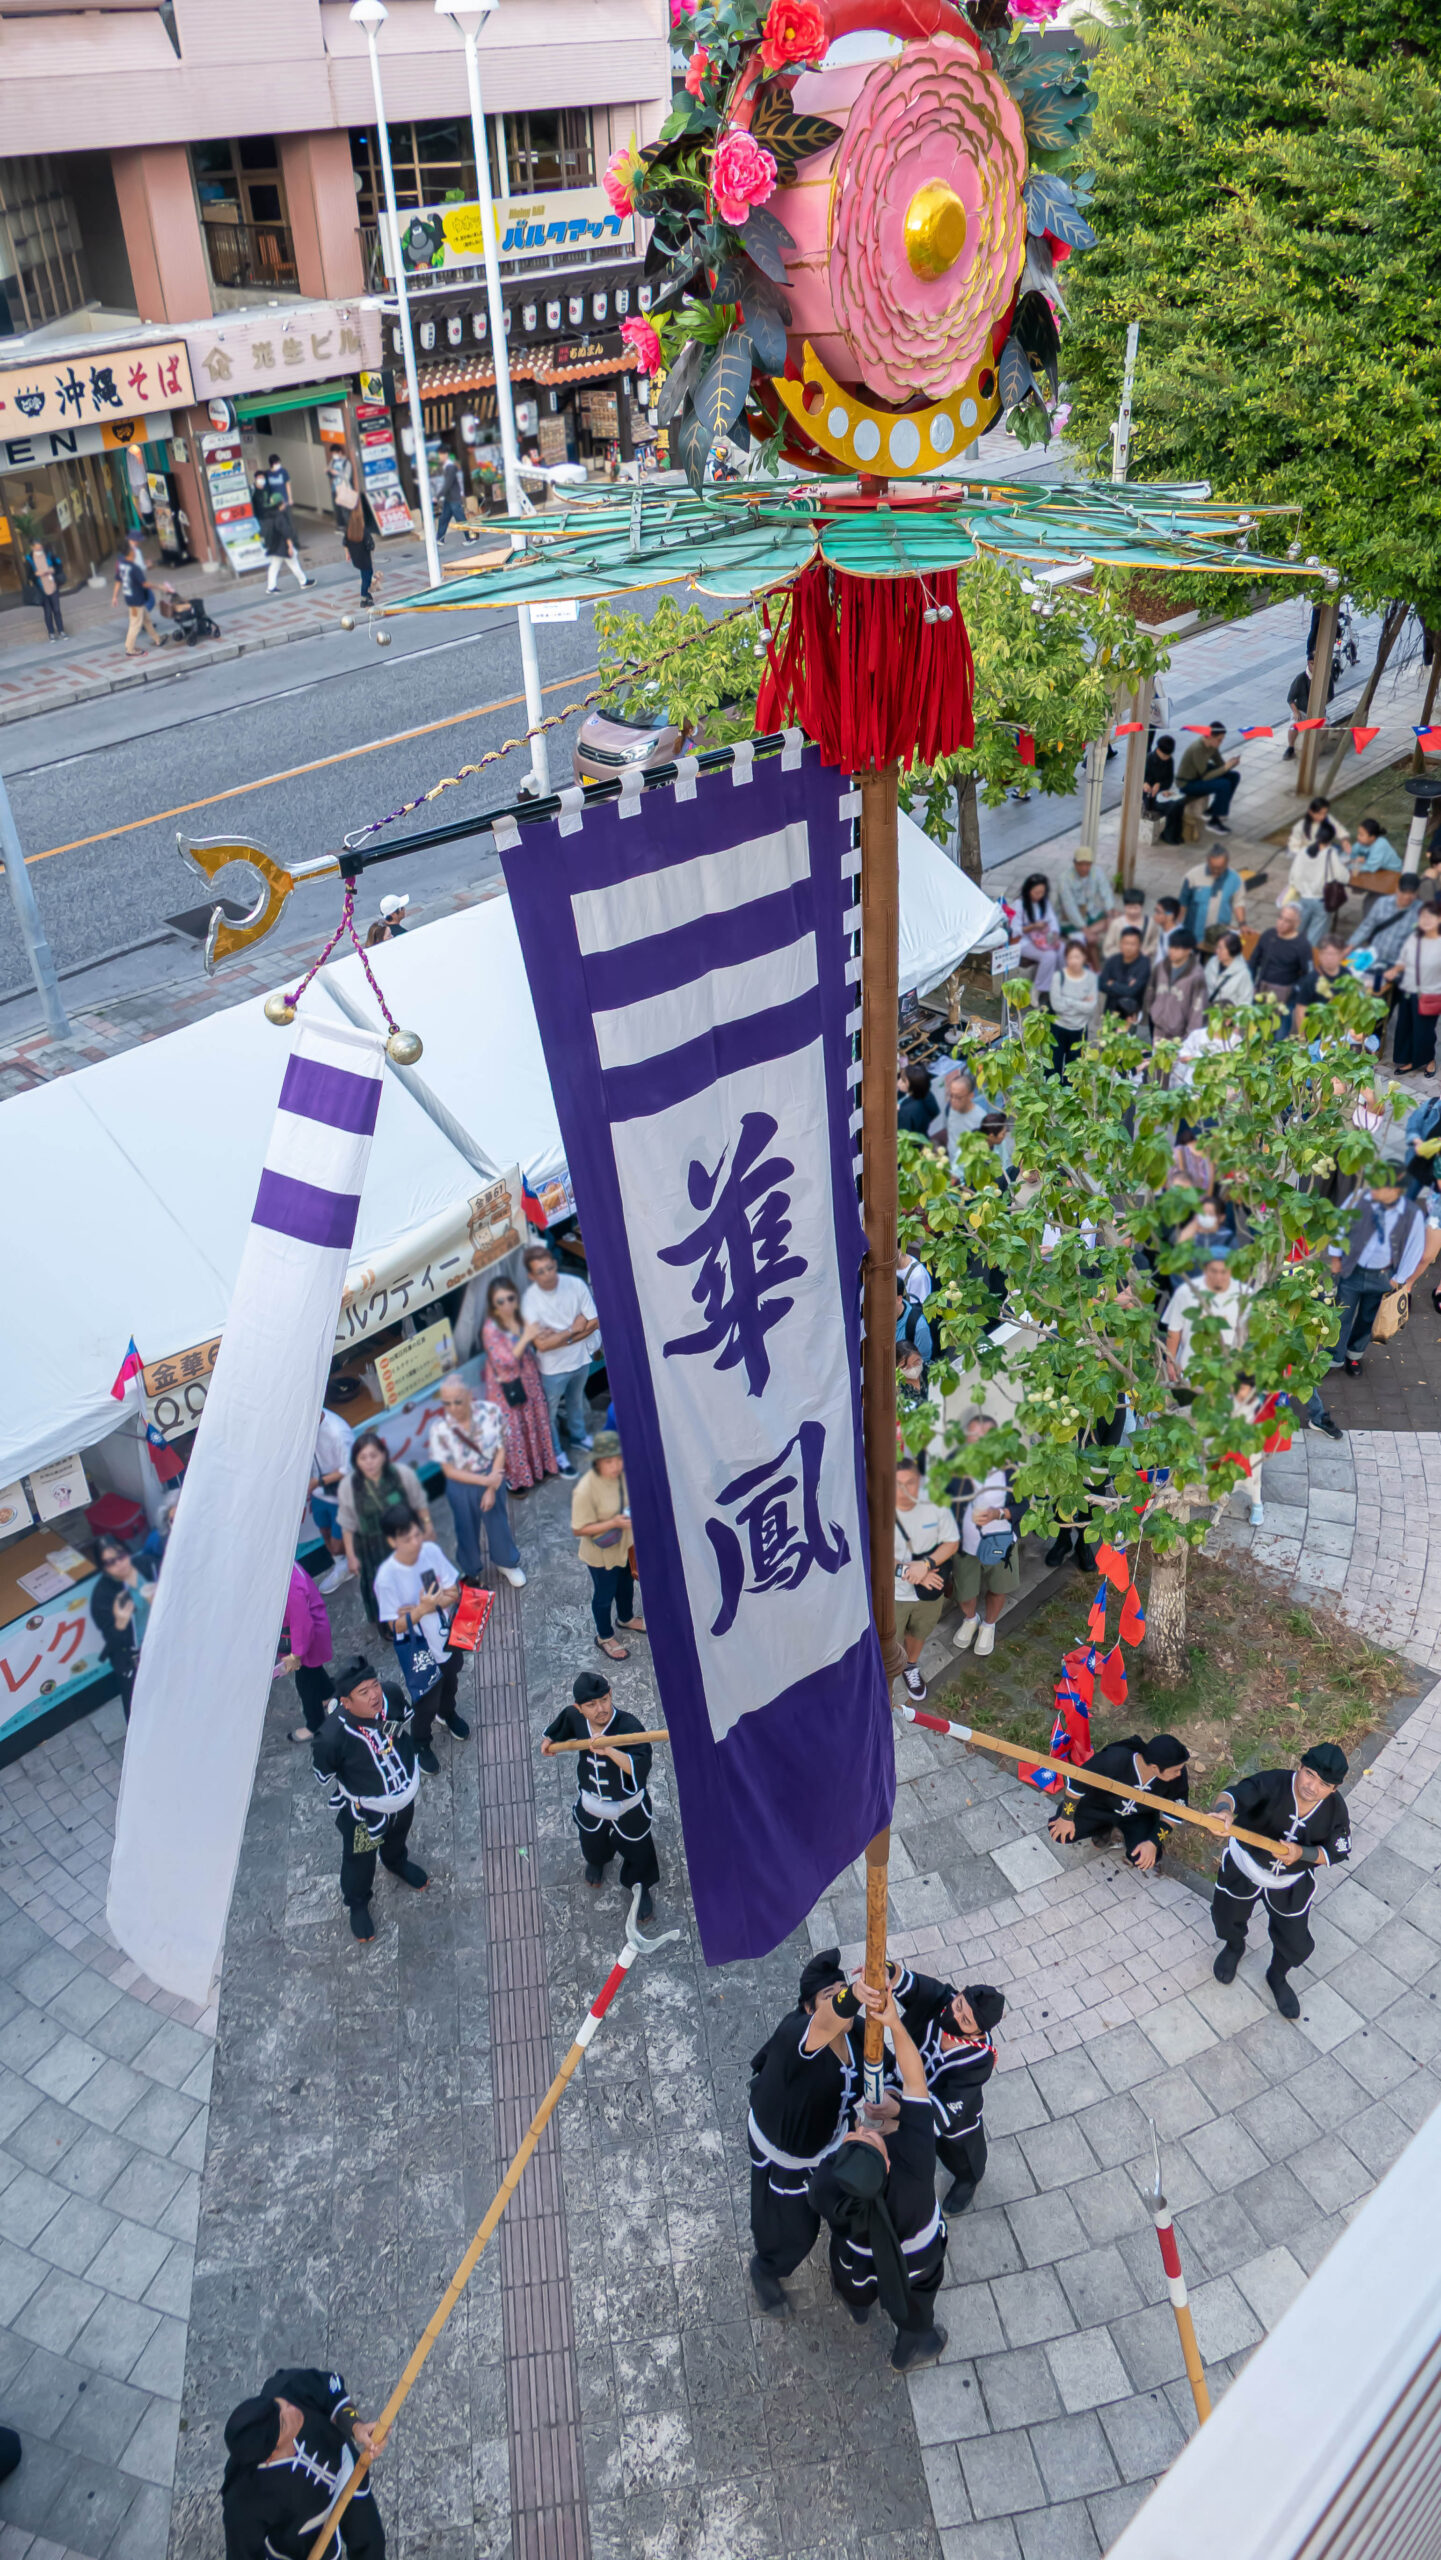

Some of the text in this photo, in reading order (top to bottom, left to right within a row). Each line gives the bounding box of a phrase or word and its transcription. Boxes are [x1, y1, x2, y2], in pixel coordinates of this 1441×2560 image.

[55, 354, 183, 419] 沖縄そば
[336, 1256, 460, 1340] ルクティー
